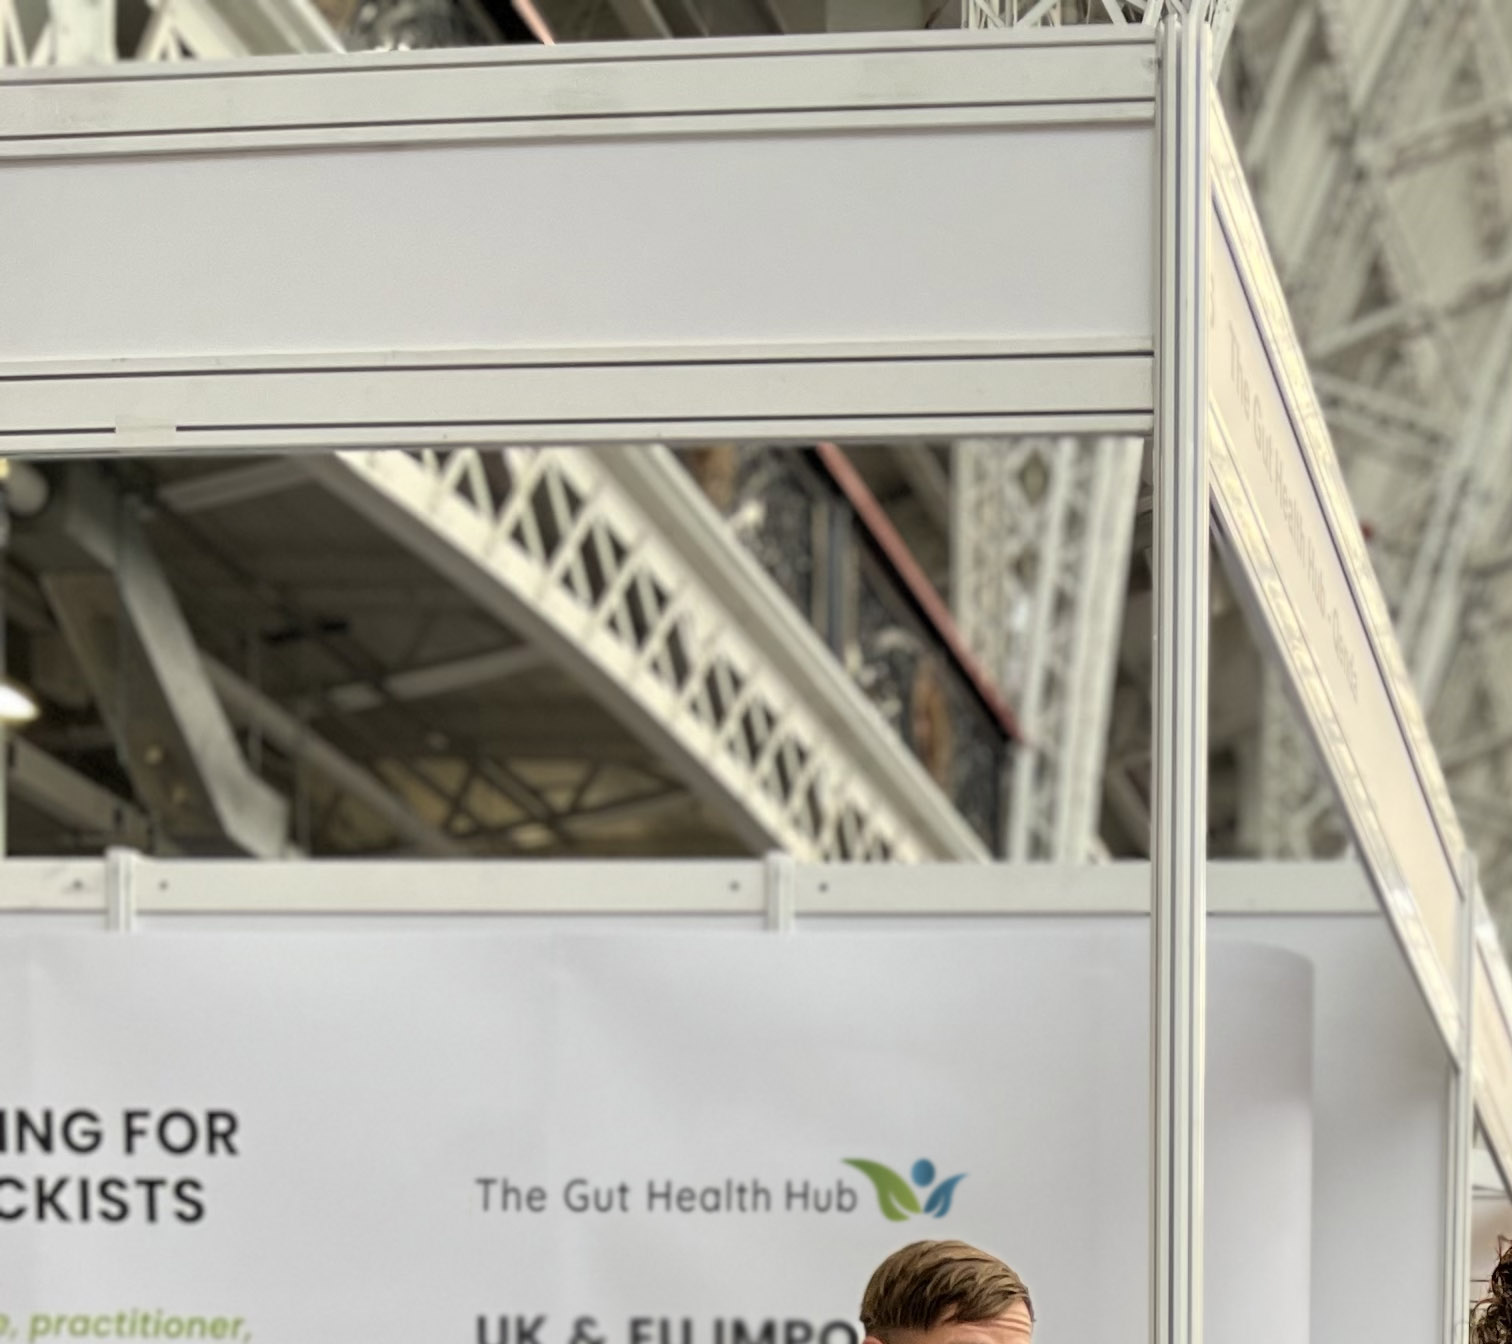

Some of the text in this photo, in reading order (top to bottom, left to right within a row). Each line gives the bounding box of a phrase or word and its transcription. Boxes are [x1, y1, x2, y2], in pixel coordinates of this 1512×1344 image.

[123, 1109, 239, 1156] FOR
[0, 1177, 206, 1223] CKISTS
[475, 1177, 858, 1213] The Gut Health Hub
[29, 1307, 253, 1344] practitioner,
